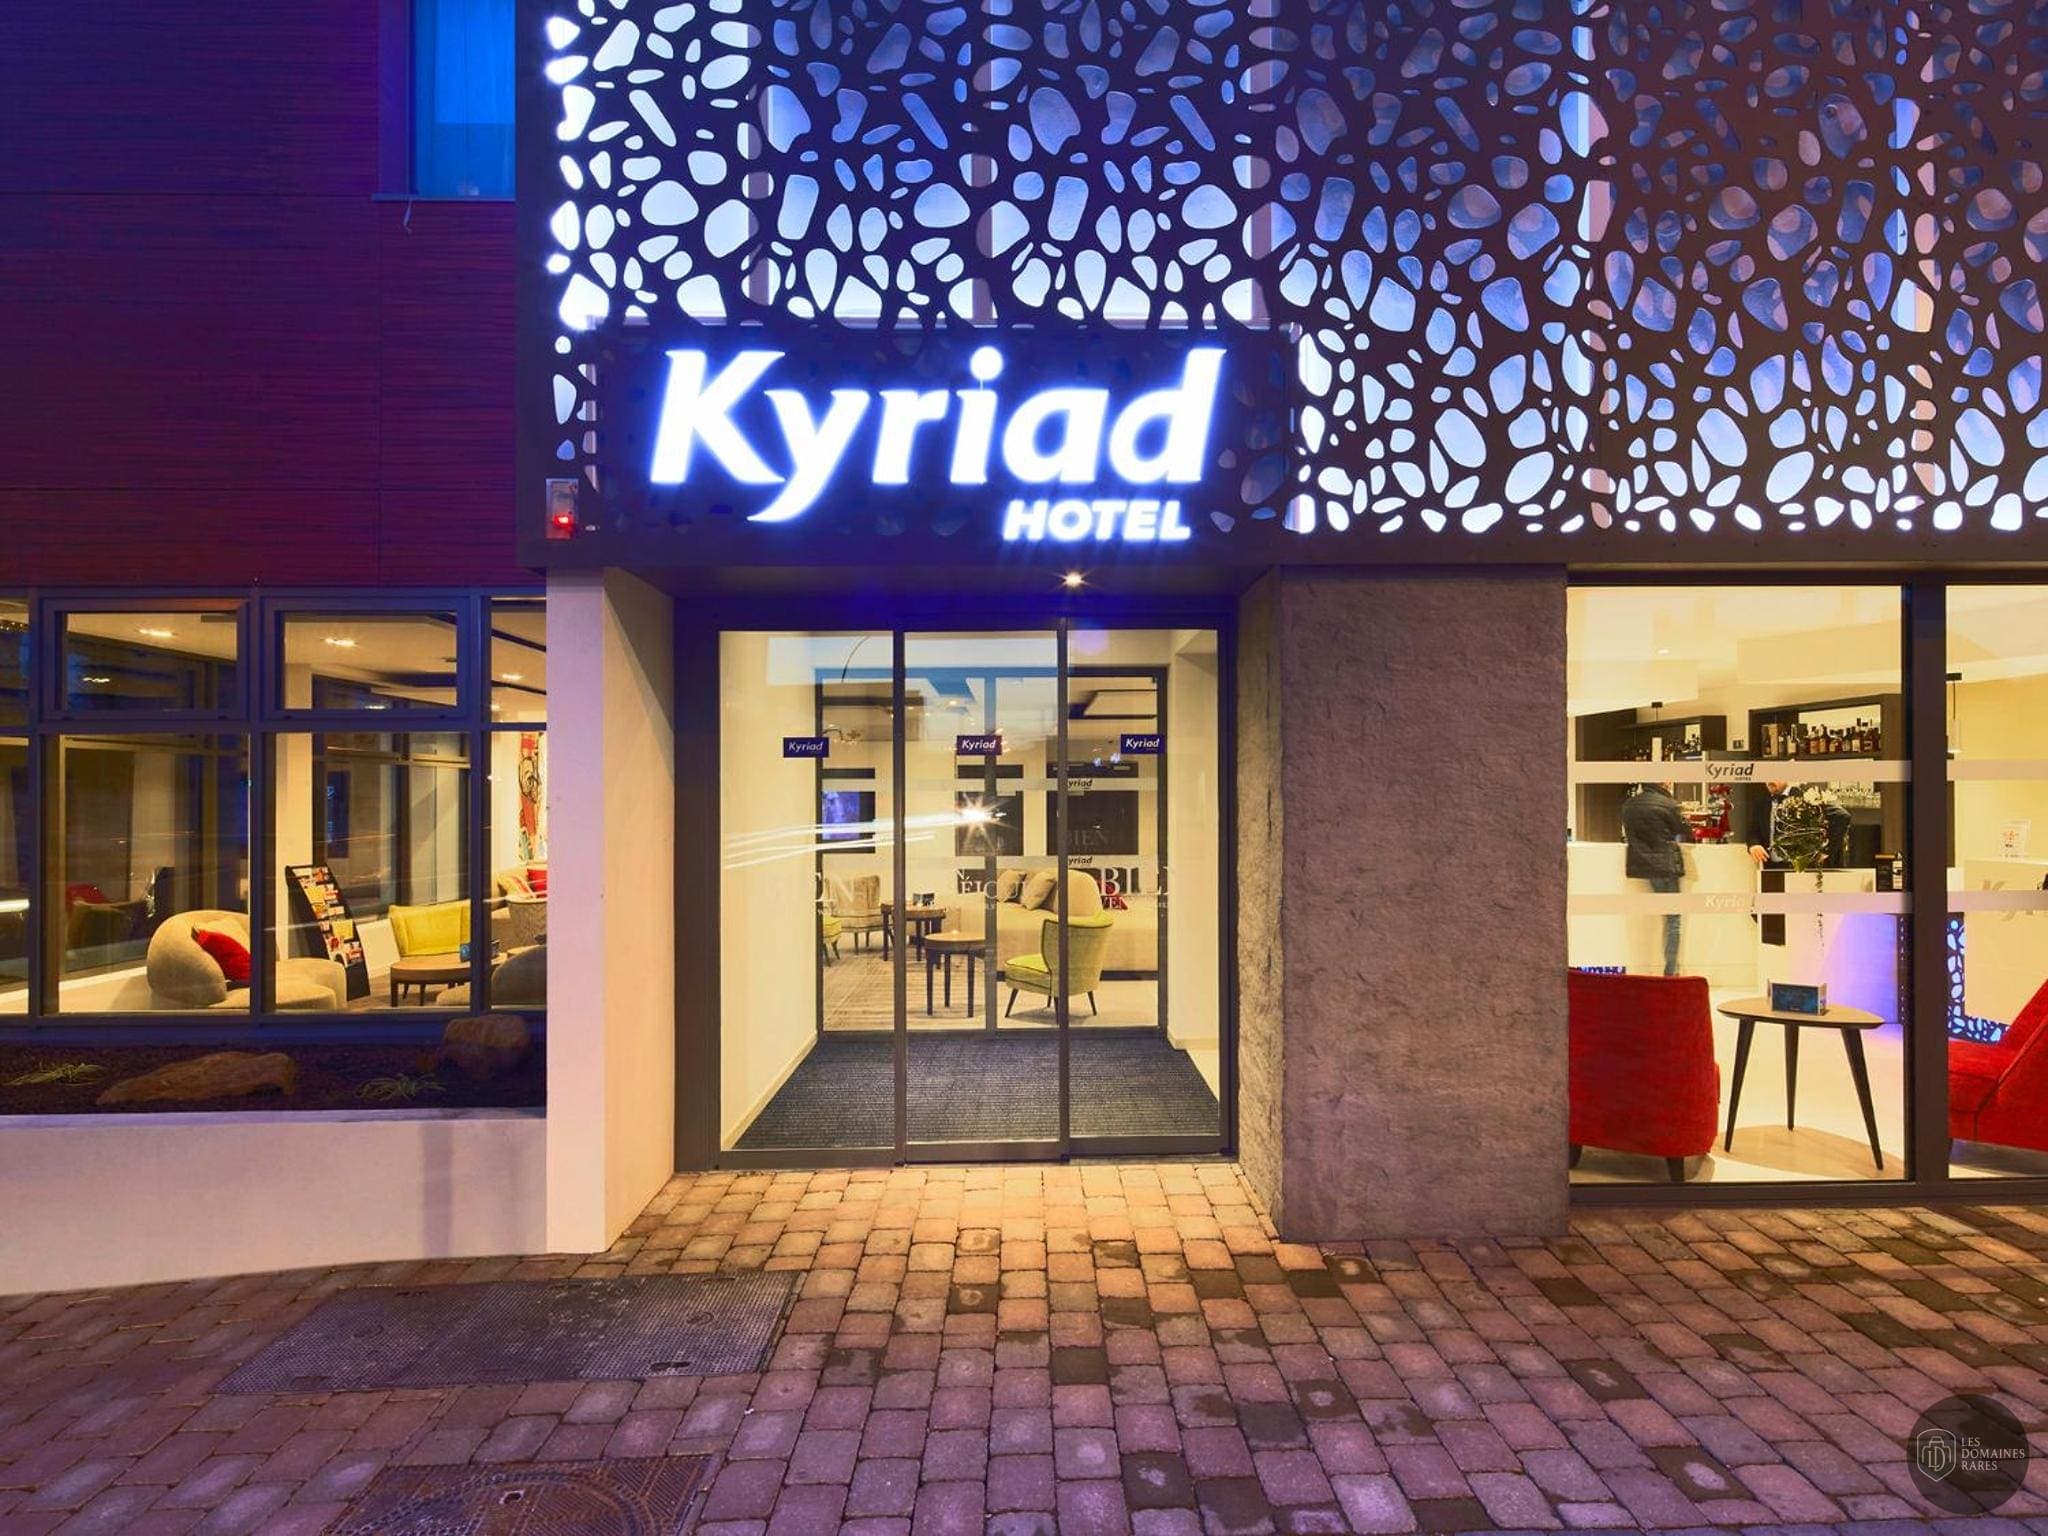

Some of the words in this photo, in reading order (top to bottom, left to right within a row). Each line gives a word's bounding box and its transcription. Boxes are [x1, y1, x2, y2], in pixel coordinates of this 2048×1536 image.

[650, 346, 1226, 523] Kyriad
[1003, 500, 1191, 542] HOTEL
[788, 741, 824, 753] Kyriad
[962, 739, 996, 751] Kyriad
[1126, 738, 1160, 749] Kyriad
[1705, 763, 1754, 780] Kyriad
[1068, 779, 1093, 789] yriad
[1068, 857, 1093, 866] yriad
